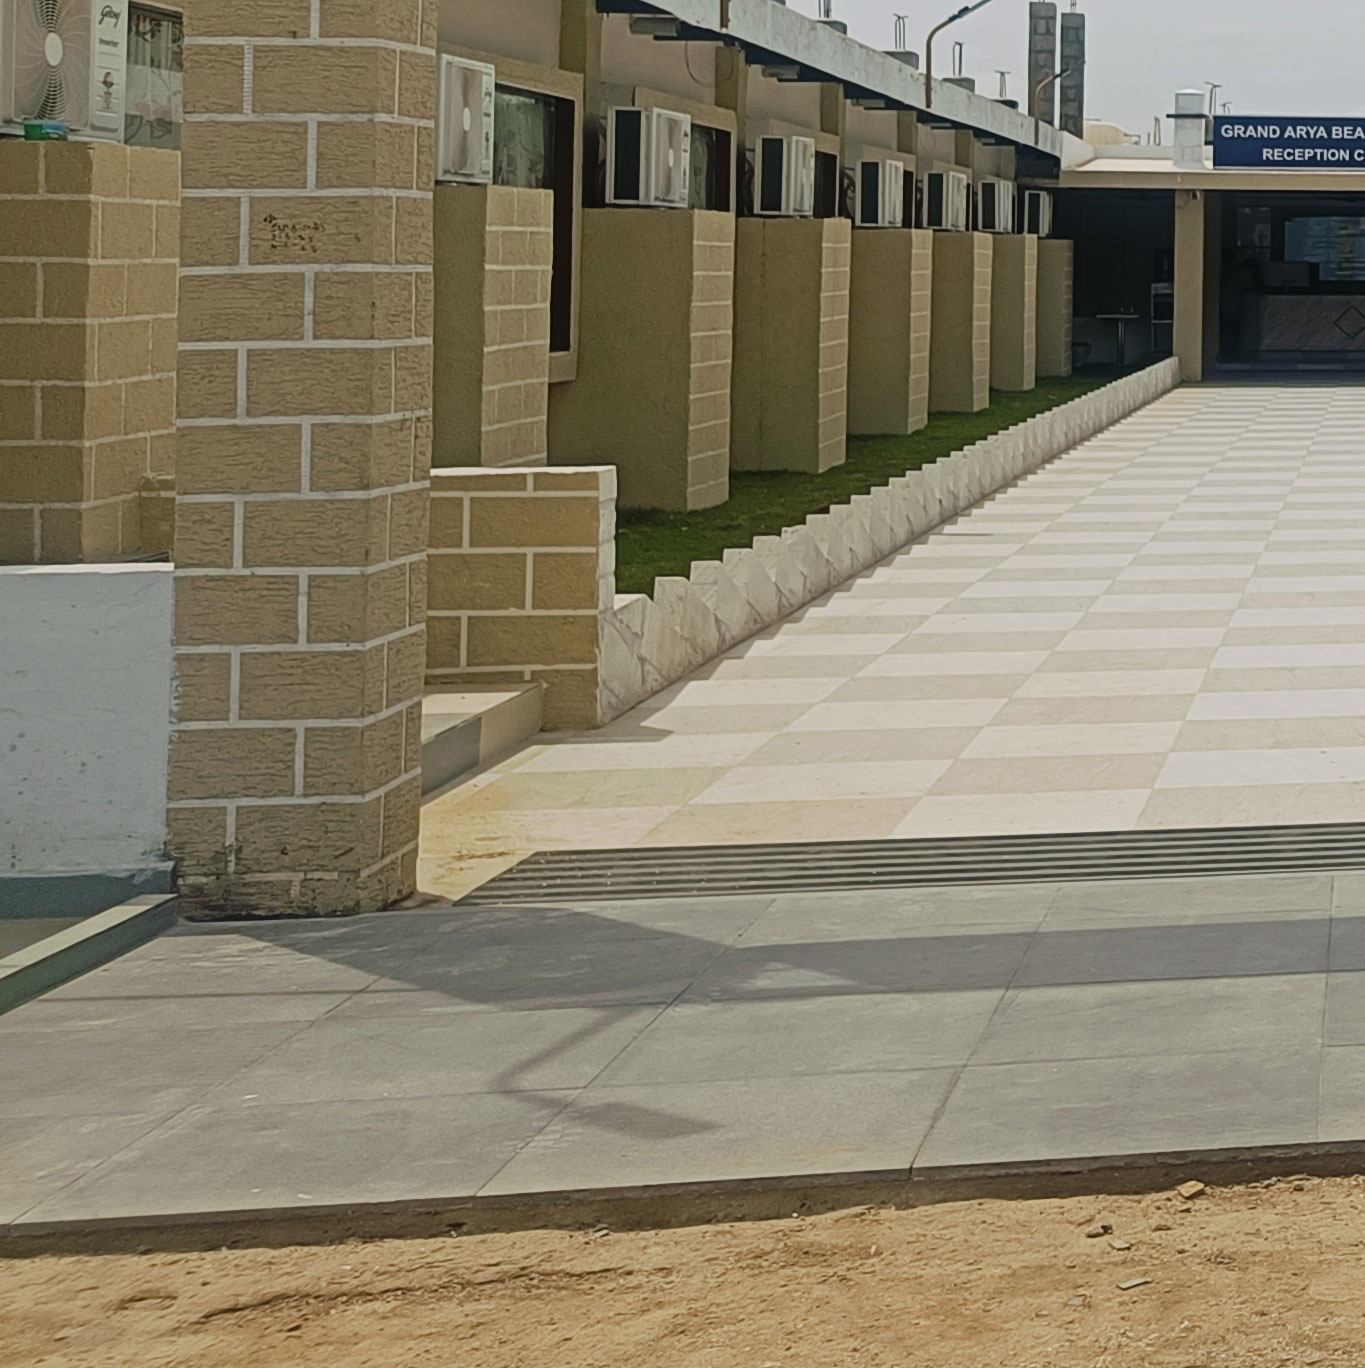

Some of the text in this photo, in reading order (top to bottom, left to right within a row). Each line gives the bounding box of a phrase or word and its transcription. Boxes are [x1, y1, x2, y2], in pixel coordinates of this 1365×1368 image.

[1220, 124, 1280, 138] GRAND
[1284, 125, 1328, 139] ARYA
[1262, 148, 1350, 161] RECEPTION
